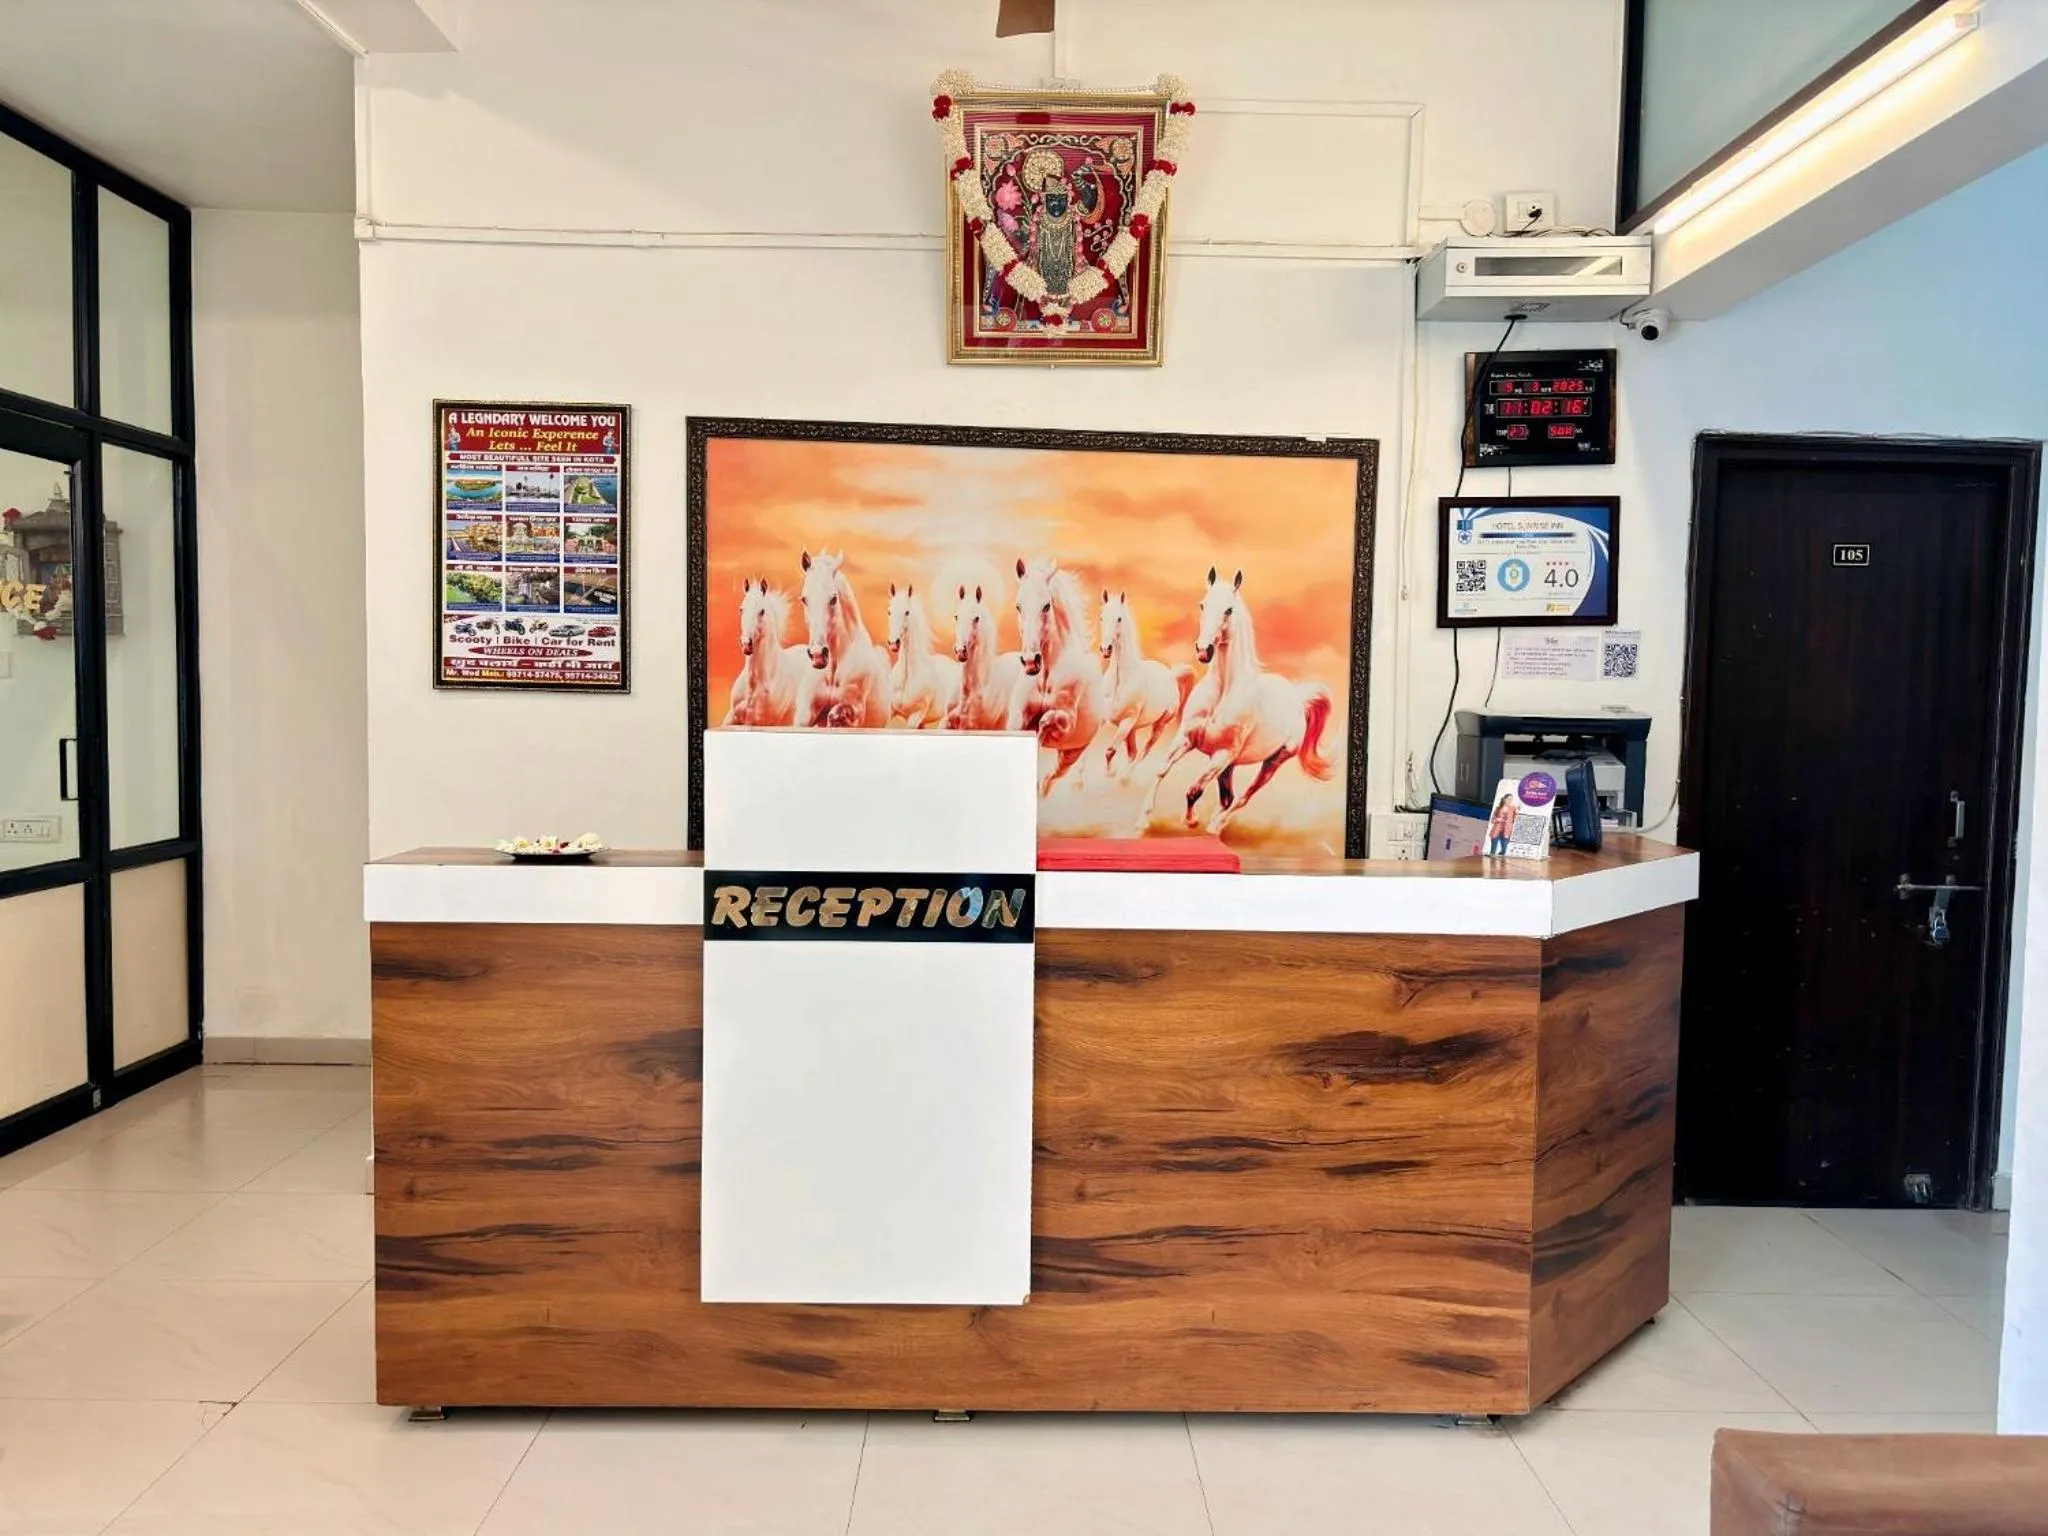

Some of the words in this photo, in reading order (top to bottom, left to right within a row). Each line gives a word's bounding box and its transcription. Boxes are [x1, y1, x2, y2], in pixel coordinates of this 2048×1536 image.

[447, 412, 458, 425] A
[461, 412, 526, 426] LEGNDARY
[529, 414, 588, 427] WELCOME
[591, 415, 616, 428] YOU
[466, 427, 485, 438] An
[488, 427, 530, 438] Iconic
[488, 440, 516, 451] Lets
[536, 441, 563, 452] Feel
[566, 441, 578, 452] It
[460, 453, 482, 461] MOST
[1840, 549, 1863, 561] 105
[1543, 568, 1579, 588] 4.0
[449, 634, 492, 645] Scooty
[503, 635, 531, 645] Bike
[541, 636, 562, 646] Car
[566, 636, 584, 646] for
[587, 638, 616, 647] Rent
[484, 647, 525, 656] WHEELS
[528, 648, 543, 656] ON
[545, 648, 578, 657] DEALS
[711, 885, 1026, 929] RECEPTION
